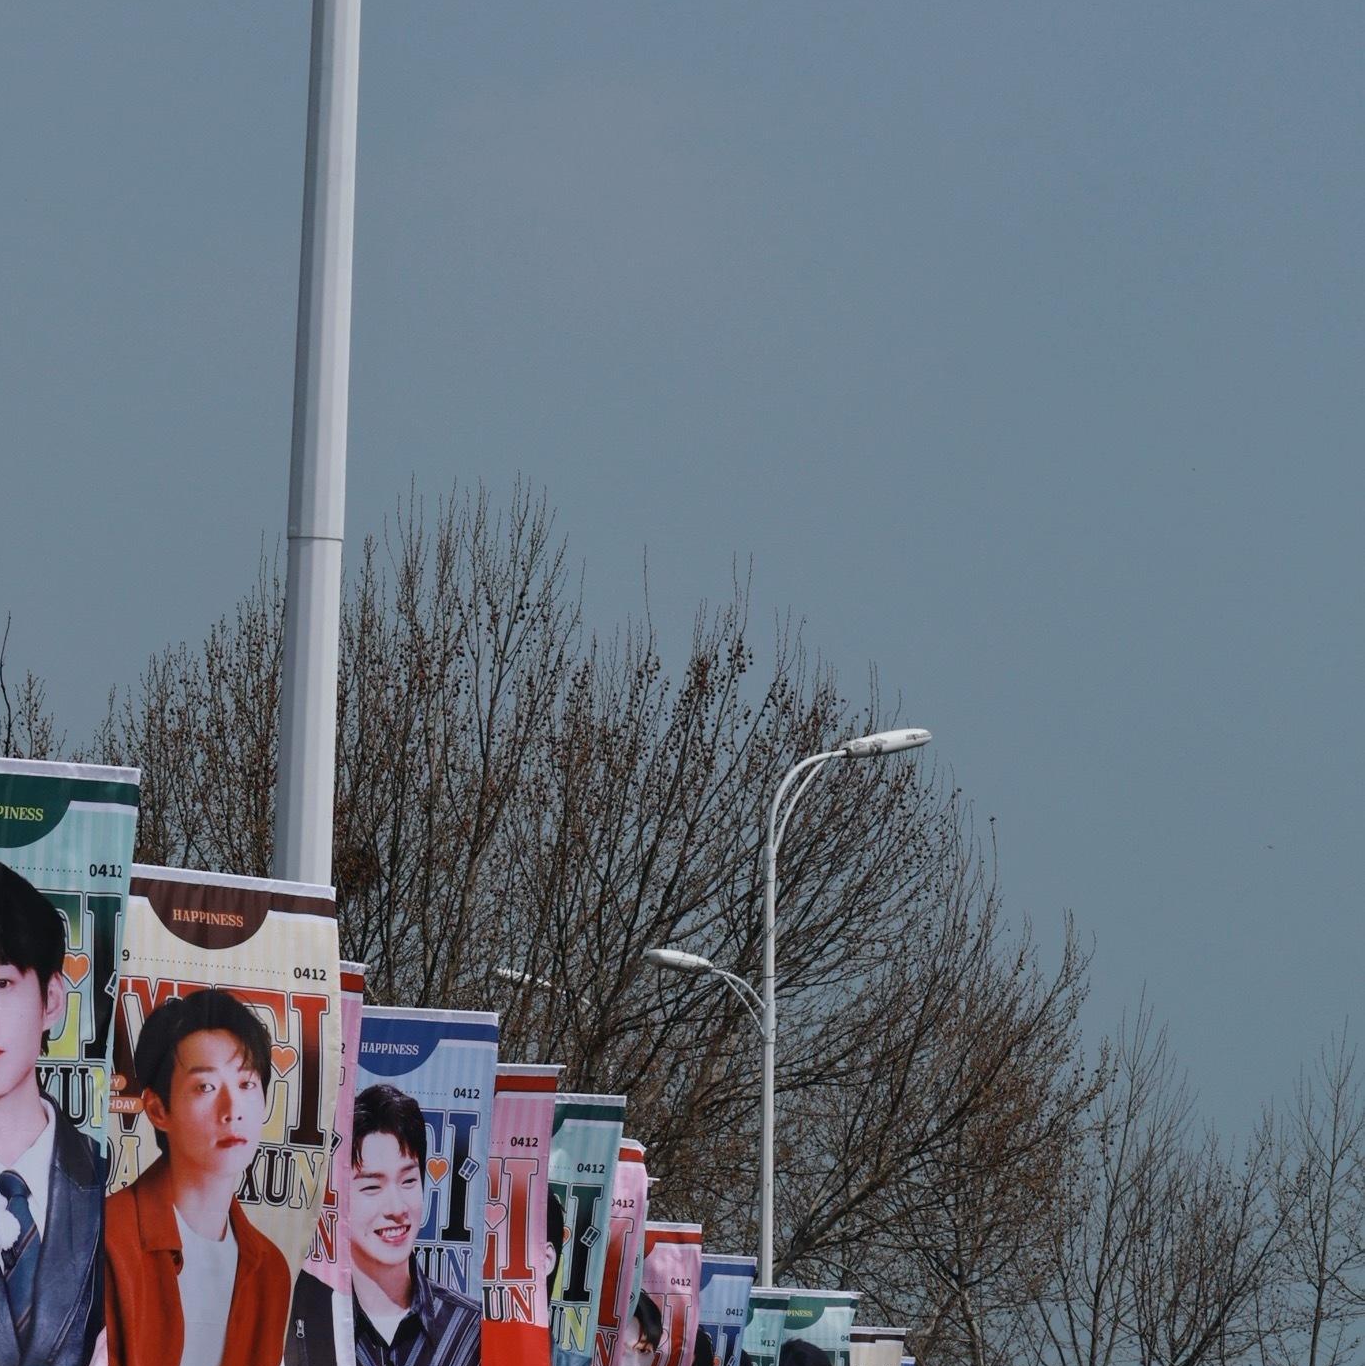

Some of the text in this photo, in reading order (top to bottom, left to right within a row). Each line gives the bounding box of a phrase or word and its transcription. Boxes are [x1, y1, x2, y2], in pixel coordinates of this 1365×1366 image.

[89, 864, 123, 878] 0412
[173, 909, 244, 929] HAPPINESS
[294, 967, 327, 982] 0412
[360, 1042, 419, 1056] HAPPINESS
[453, 1087, 480, 1099] 0412
[510, 1137, 538, 1148] 0412
[577, 1162, 605, 1174] 0412
[671, 1277, 691, 1287] 0412
[725, 1307, 743, 1317] 0412
